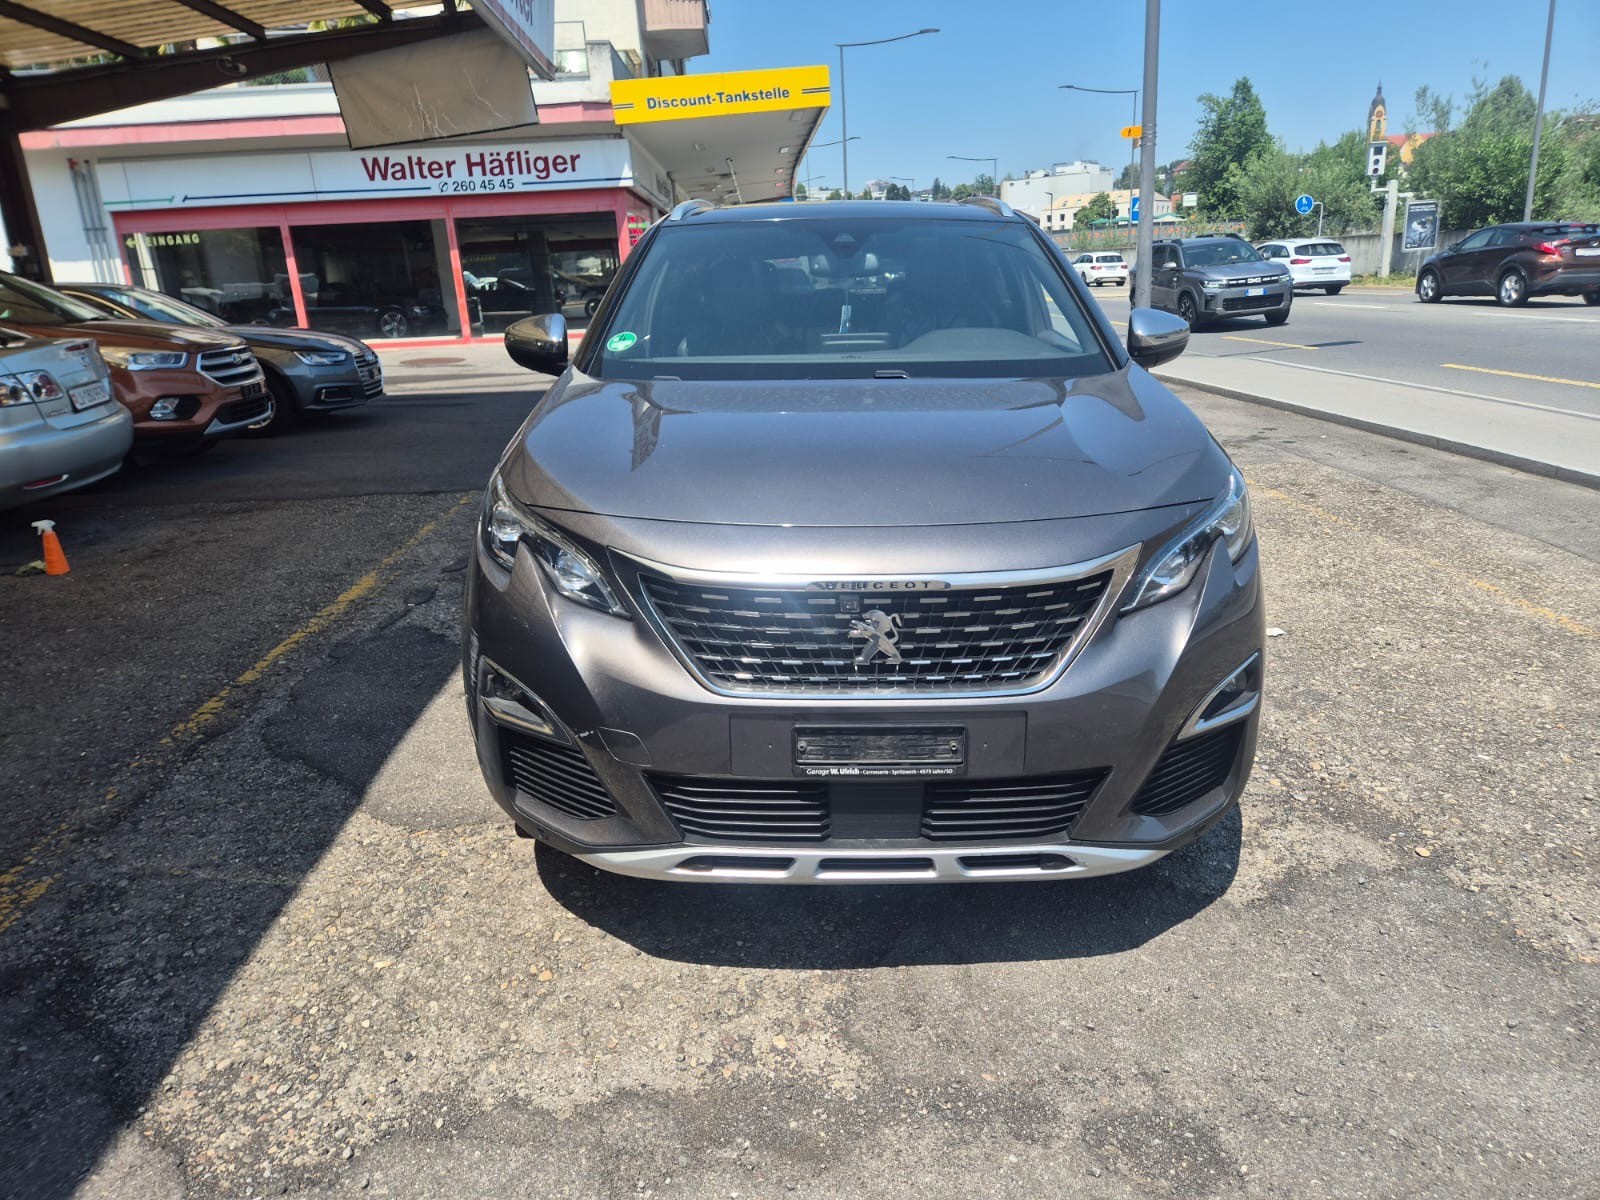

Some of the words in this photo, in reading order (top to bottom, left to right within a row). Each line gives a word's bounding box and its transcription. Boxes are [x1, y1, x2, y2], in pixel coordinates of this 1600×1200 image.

[647, 87, 790, 109] Discount-Tankstelle
[361, 153, 456, 181] Walter
[465, 150, 581, 179] Häfliger
[452, 180, 476, 193] 260
[479, 179, 496, 191] 45
[499, 178, 515, 190] 45
[144, 233, 200, 247] EINGANG
[806, 768, 829, 776] Garage
[840, 767, 859, 775] Ulrich
